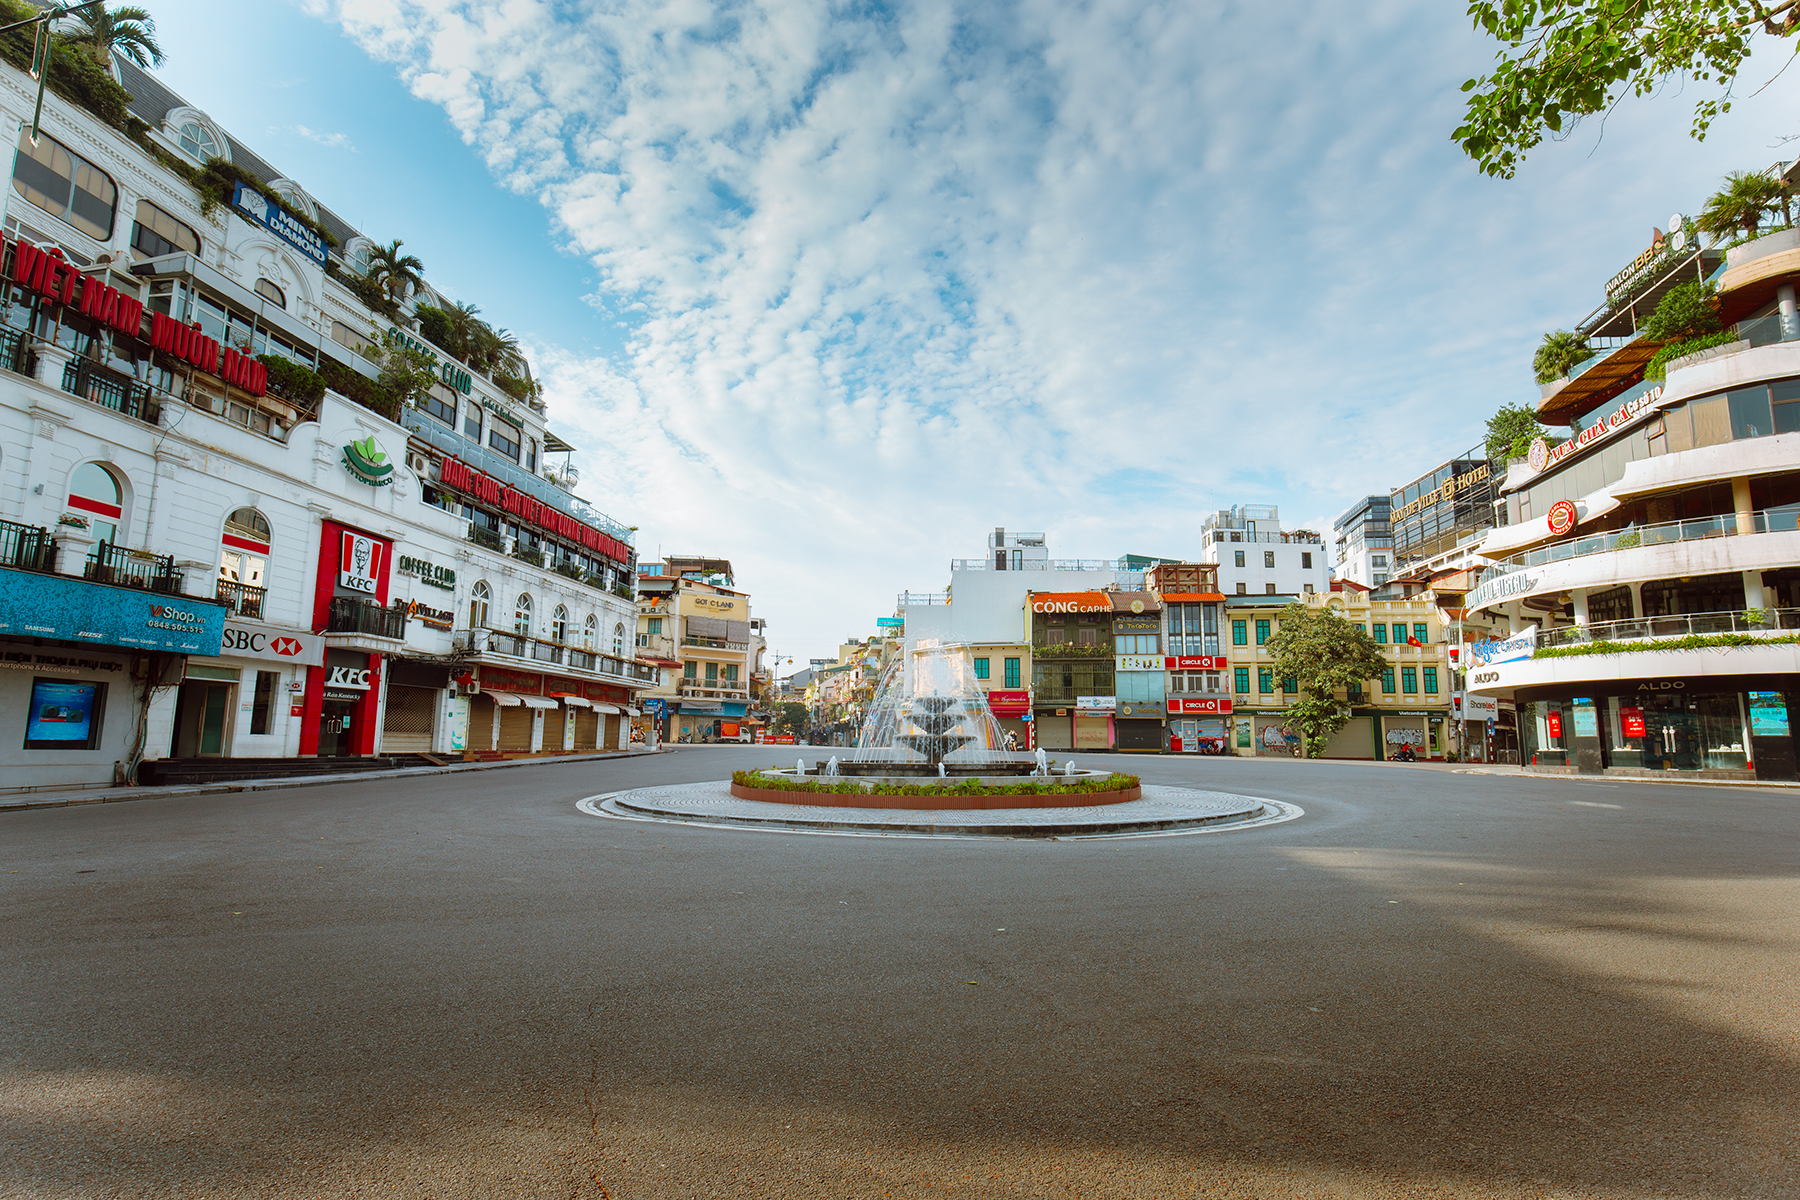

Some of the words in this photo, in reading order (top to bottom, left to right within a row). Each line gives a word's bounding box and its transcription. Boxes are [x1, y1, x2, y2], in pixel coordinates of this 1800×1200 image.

[279, 210, 321, 248] MINH
[270, 217, 326, 262] DIAMOND
[1605, 263, 1636, 294] AVALON
[1636, 238, 1667, 269] BBQ
[13, 239, 81, 306] VIỆT
[80, 275, 143, 338] NAM
[150, 310, 219, 374] MUÔN
[223, 346, 268, 397] NĂM
[443, 362, 472, 395] CLUB
[1650, 385, 1662, 402] 10
[1390, 507, 1404, 524] MAY
[1406, 501, 1417, 516] DE
[1418, 489, 1439, 510] VILLE
[1457, 464, 1490, 490] HOTEL
[441, 454, 472, 492] ĐẢNG
[473, 470, 500, 504] CỘNG
[501, 482, 521, 514] SẢN
[520, 494, 539, 525] VIỆT
[538, 504, 558, 531] NAM
[557, 513, 581, 542] QUANG
[581, 525, 598, 552] VINH
[597, 533, 615, 558] MUÔN
[614, 539, 628, 564] NĂM
[399, 554, 433, 577] COFFEE
[434, 565, 456, 583] CLUB
[346, 575, 373, 591] KFC
[24, 625, 55, 633] SAMSUNG
[148, 620, 203, 634] 0848.505.515
[1473, 637, 1501, 663] Tiger
[1500, 636, 1535, 652] CRYSTAL
[41, 665, 80, 674] Accessories
[68, 658, 77, 666] &
[1202, 658, 1210, 667] K
[328, 666, 371, 686] KFC
[1474, 671, 1500, 683] ALDO
[1637, 681, 1686, 691] ALDO
[1206, 701, 1215, 710] K
